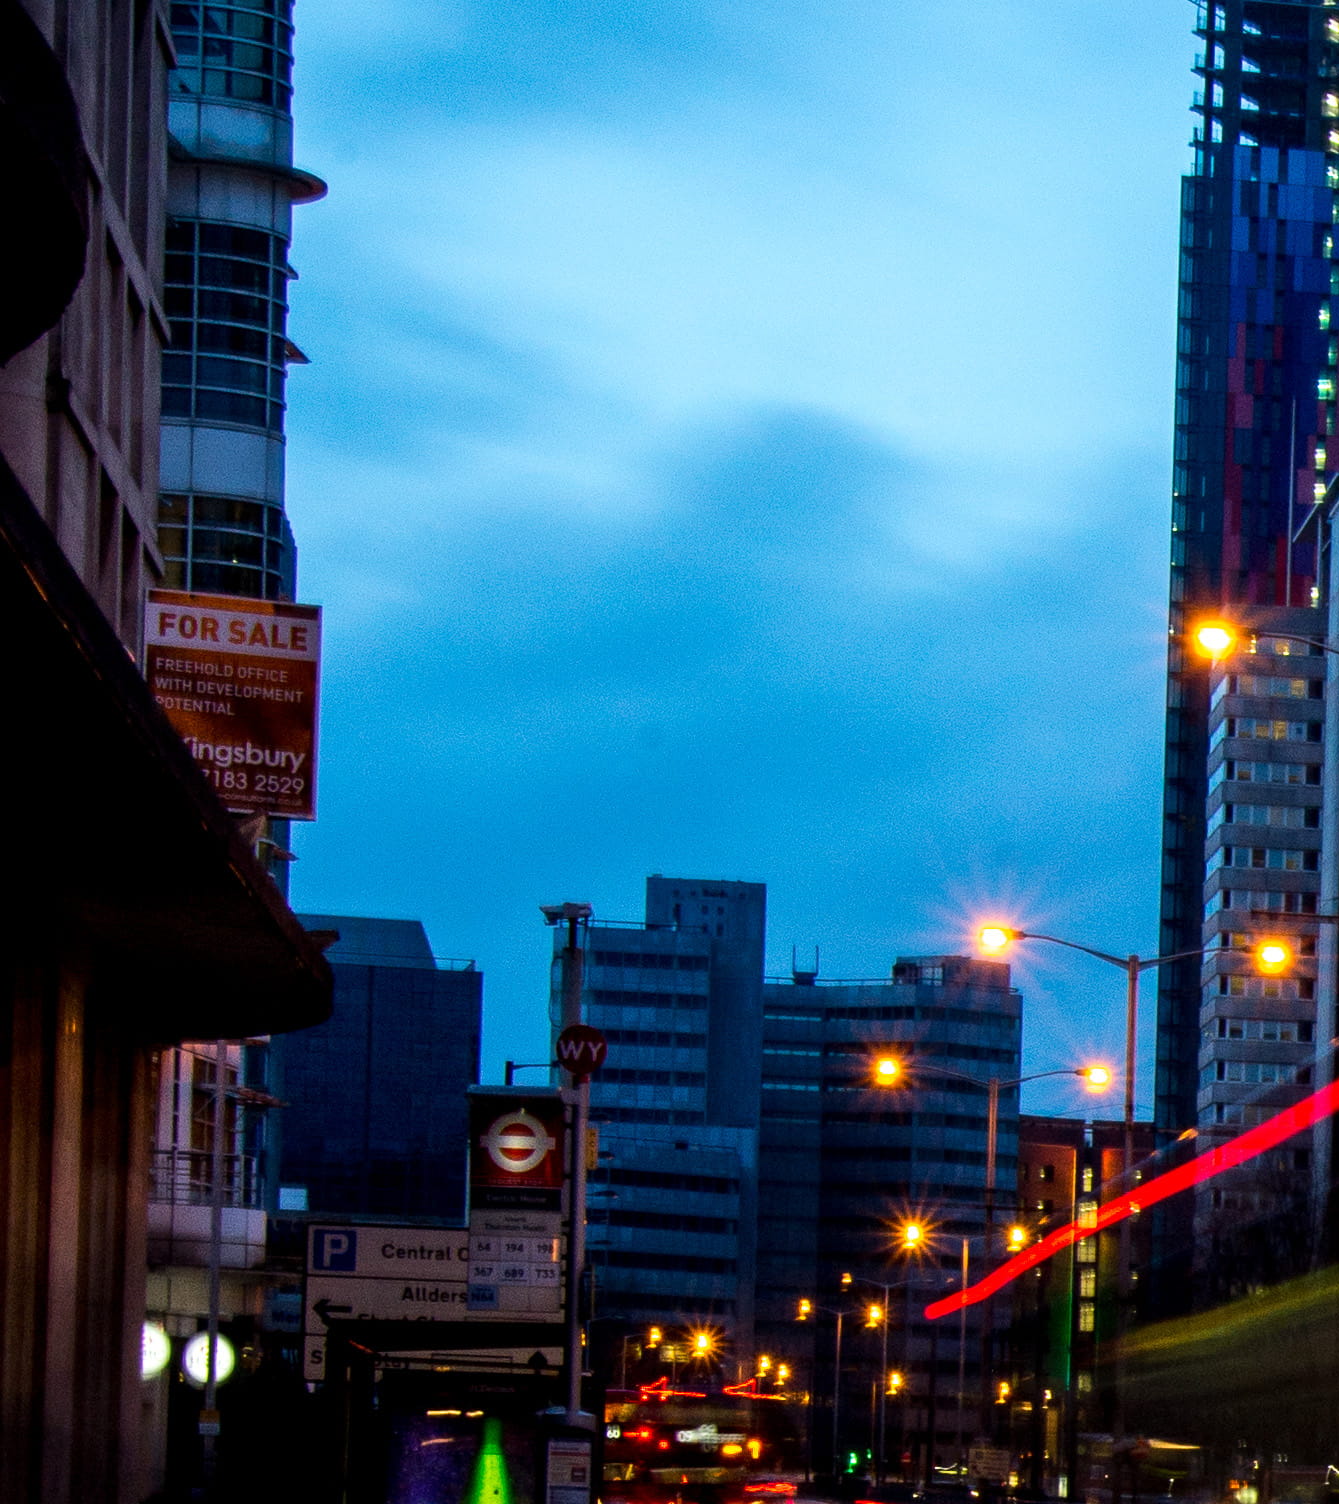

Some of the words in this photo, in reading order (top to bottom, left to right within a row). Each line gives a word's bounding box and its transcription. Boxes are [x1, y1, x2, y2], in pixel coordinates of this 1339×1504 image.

[159, 612, 219, 642] FOR
[228, 620, 308, 651] SALE
[156, 657, 233, 677] FREEHOLD
[238, 667, 288, 683] OFFICE
[155, 677, 192, 692] WITH
[196, 681, 304, 703] DEVELOPMENT
[255, 775, 304, 795] 2529
[560, 1040, 603, 1061] WY
[381, 1244, 449, 1260] Central
[401, 1286, 468, 1303] Allders
